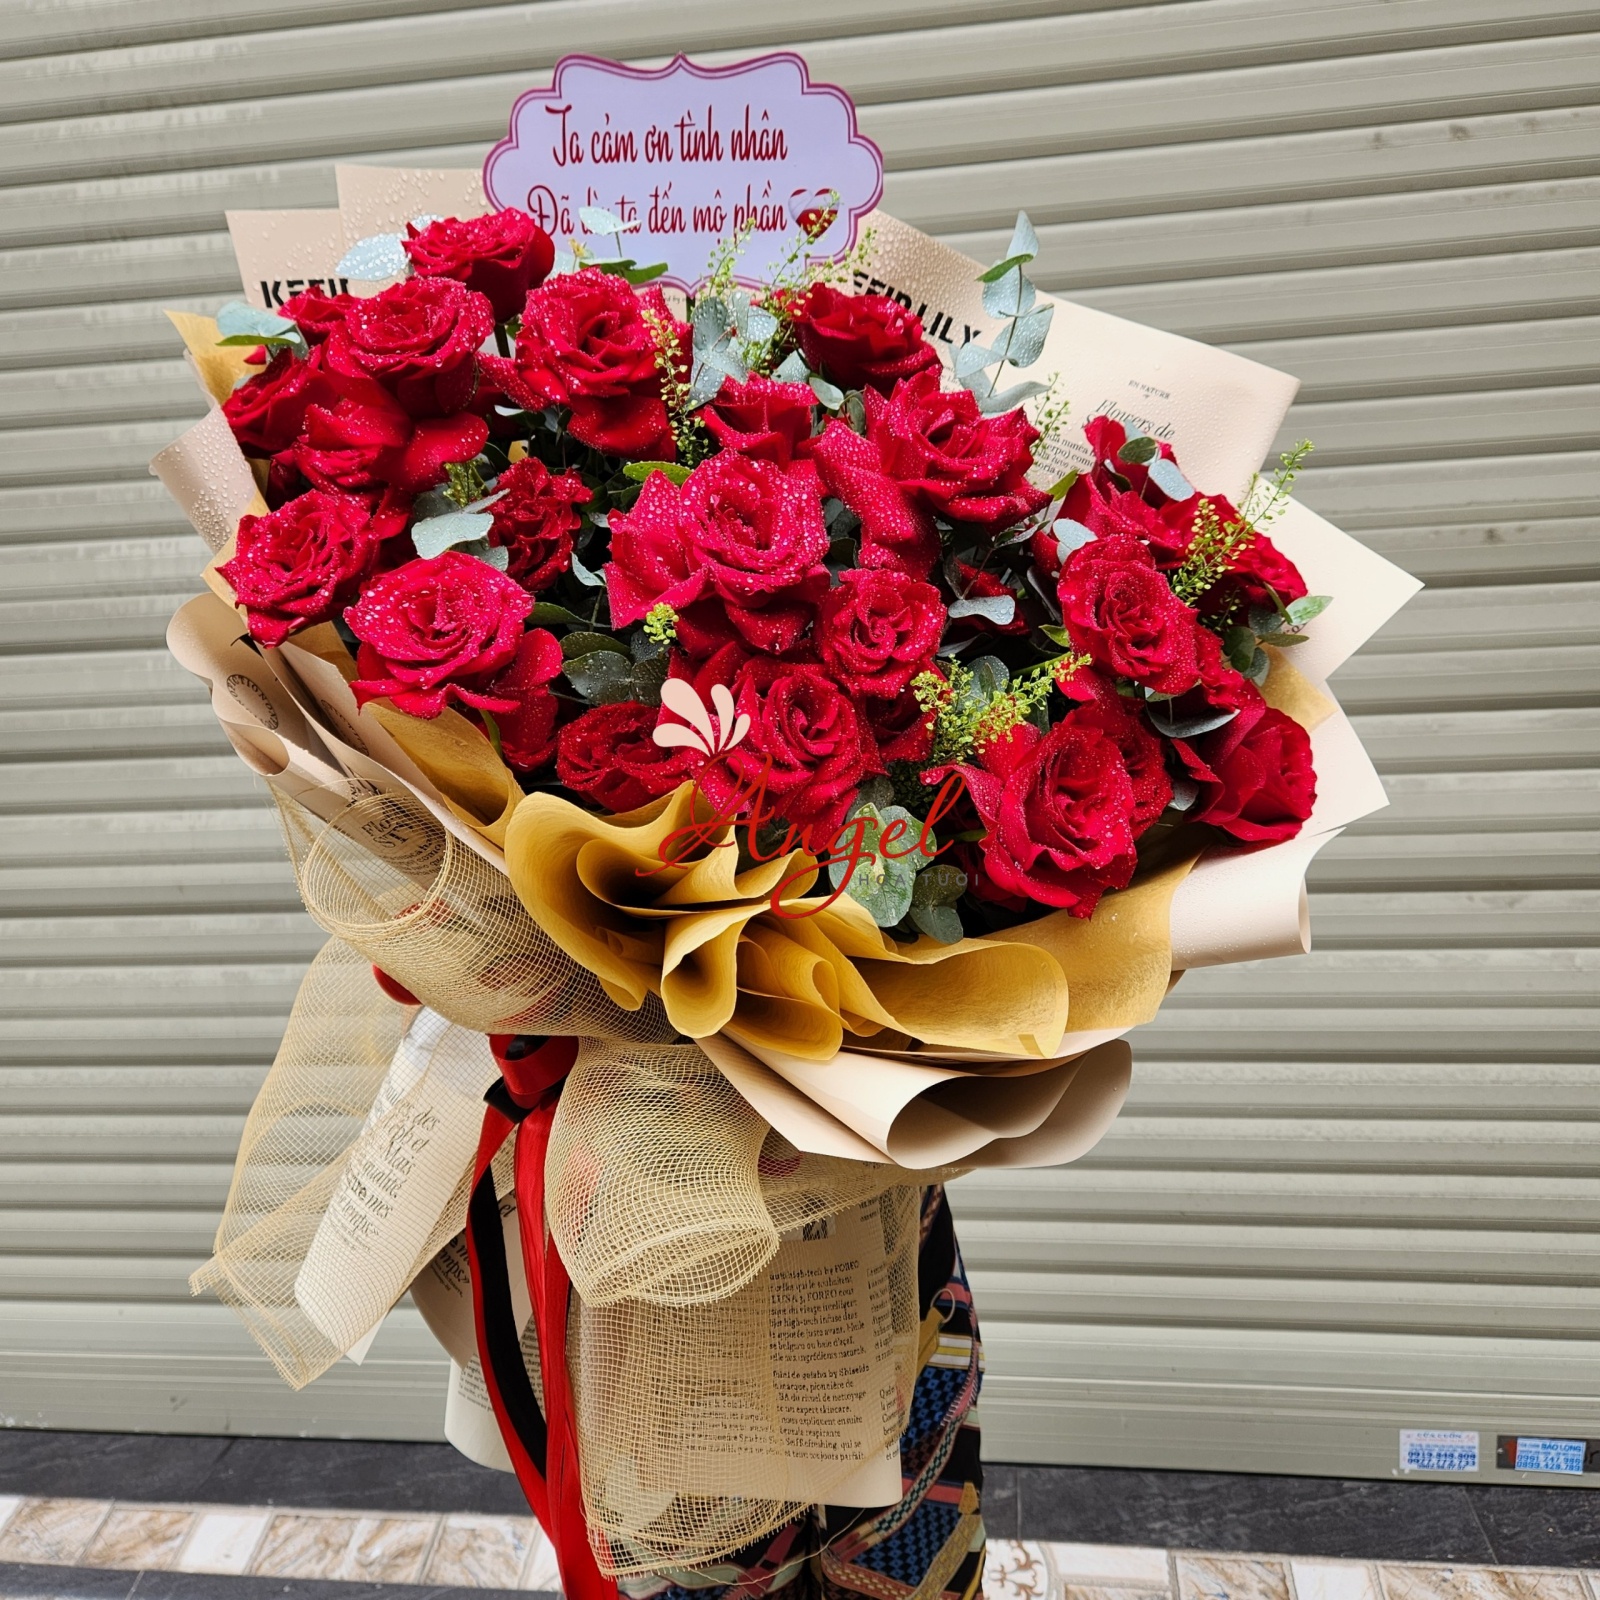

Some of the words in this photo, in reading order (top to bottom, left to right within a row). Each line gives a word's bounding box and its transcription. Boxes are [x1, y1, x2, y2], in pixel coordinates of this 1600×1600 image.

[545, 104, 584, 167] Ta
[591, 113, 638, 164] cảm
[645, 125, 673, 163] ơn
[674, 104, 724, 162] tình
[731, 104, 788, 161] nhân
[527, 184, 574, 236] Đã
[648, 181, 687, 234] đến
[693, 189, 727, 245] mộ
[1095, 399, 1152, 435] Flowers
[1152, 422, 1175, 439] de
[828, 1369, 838, 1379] by
